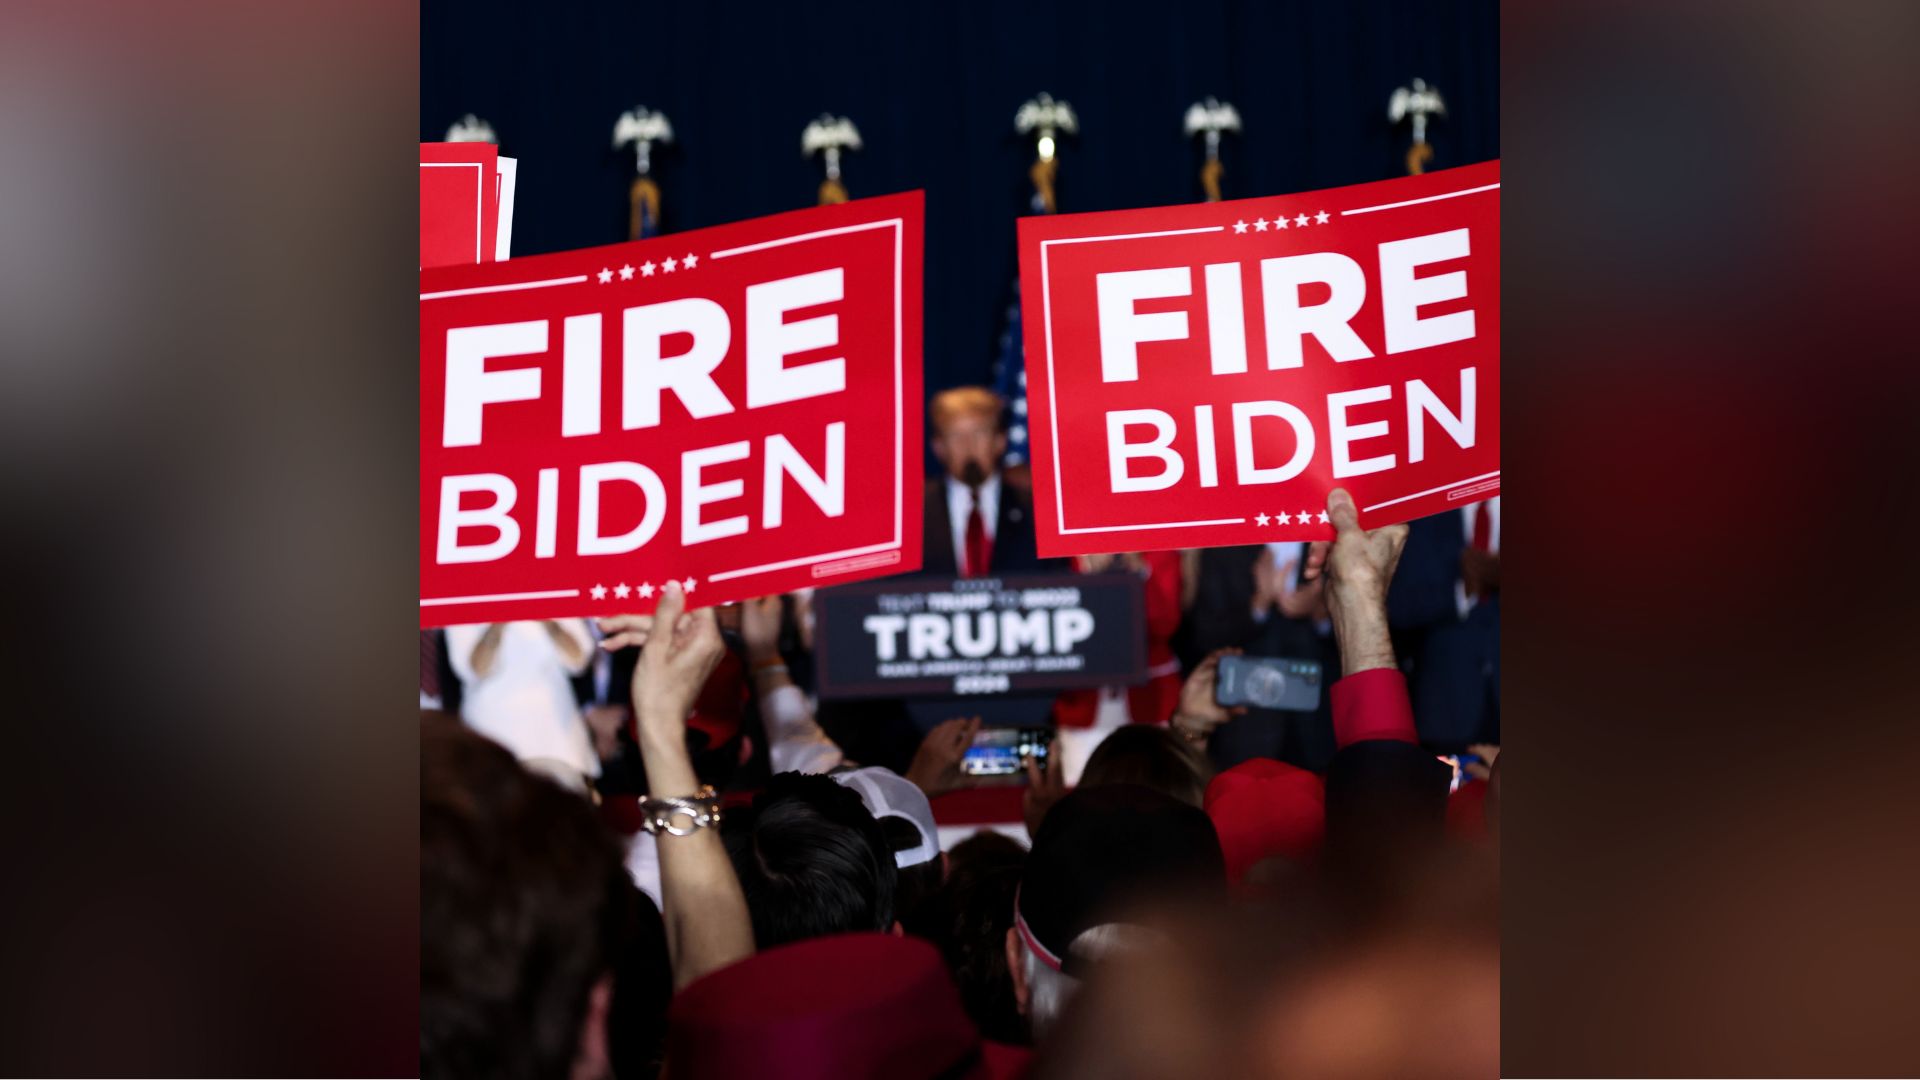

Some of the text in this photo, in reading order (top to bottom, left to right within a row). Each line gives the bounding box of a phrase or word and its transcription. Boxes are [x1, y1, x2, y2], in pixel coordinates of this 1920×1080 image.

[443, 267, 846, 448] FIRE
[1097, 228, 1476, 383] FIRE
[436, 421, 845, 564] BIDEN
[1105, 366, 1476, 493] BIDEN
[864, 607, 1094, 661] TRUMP
